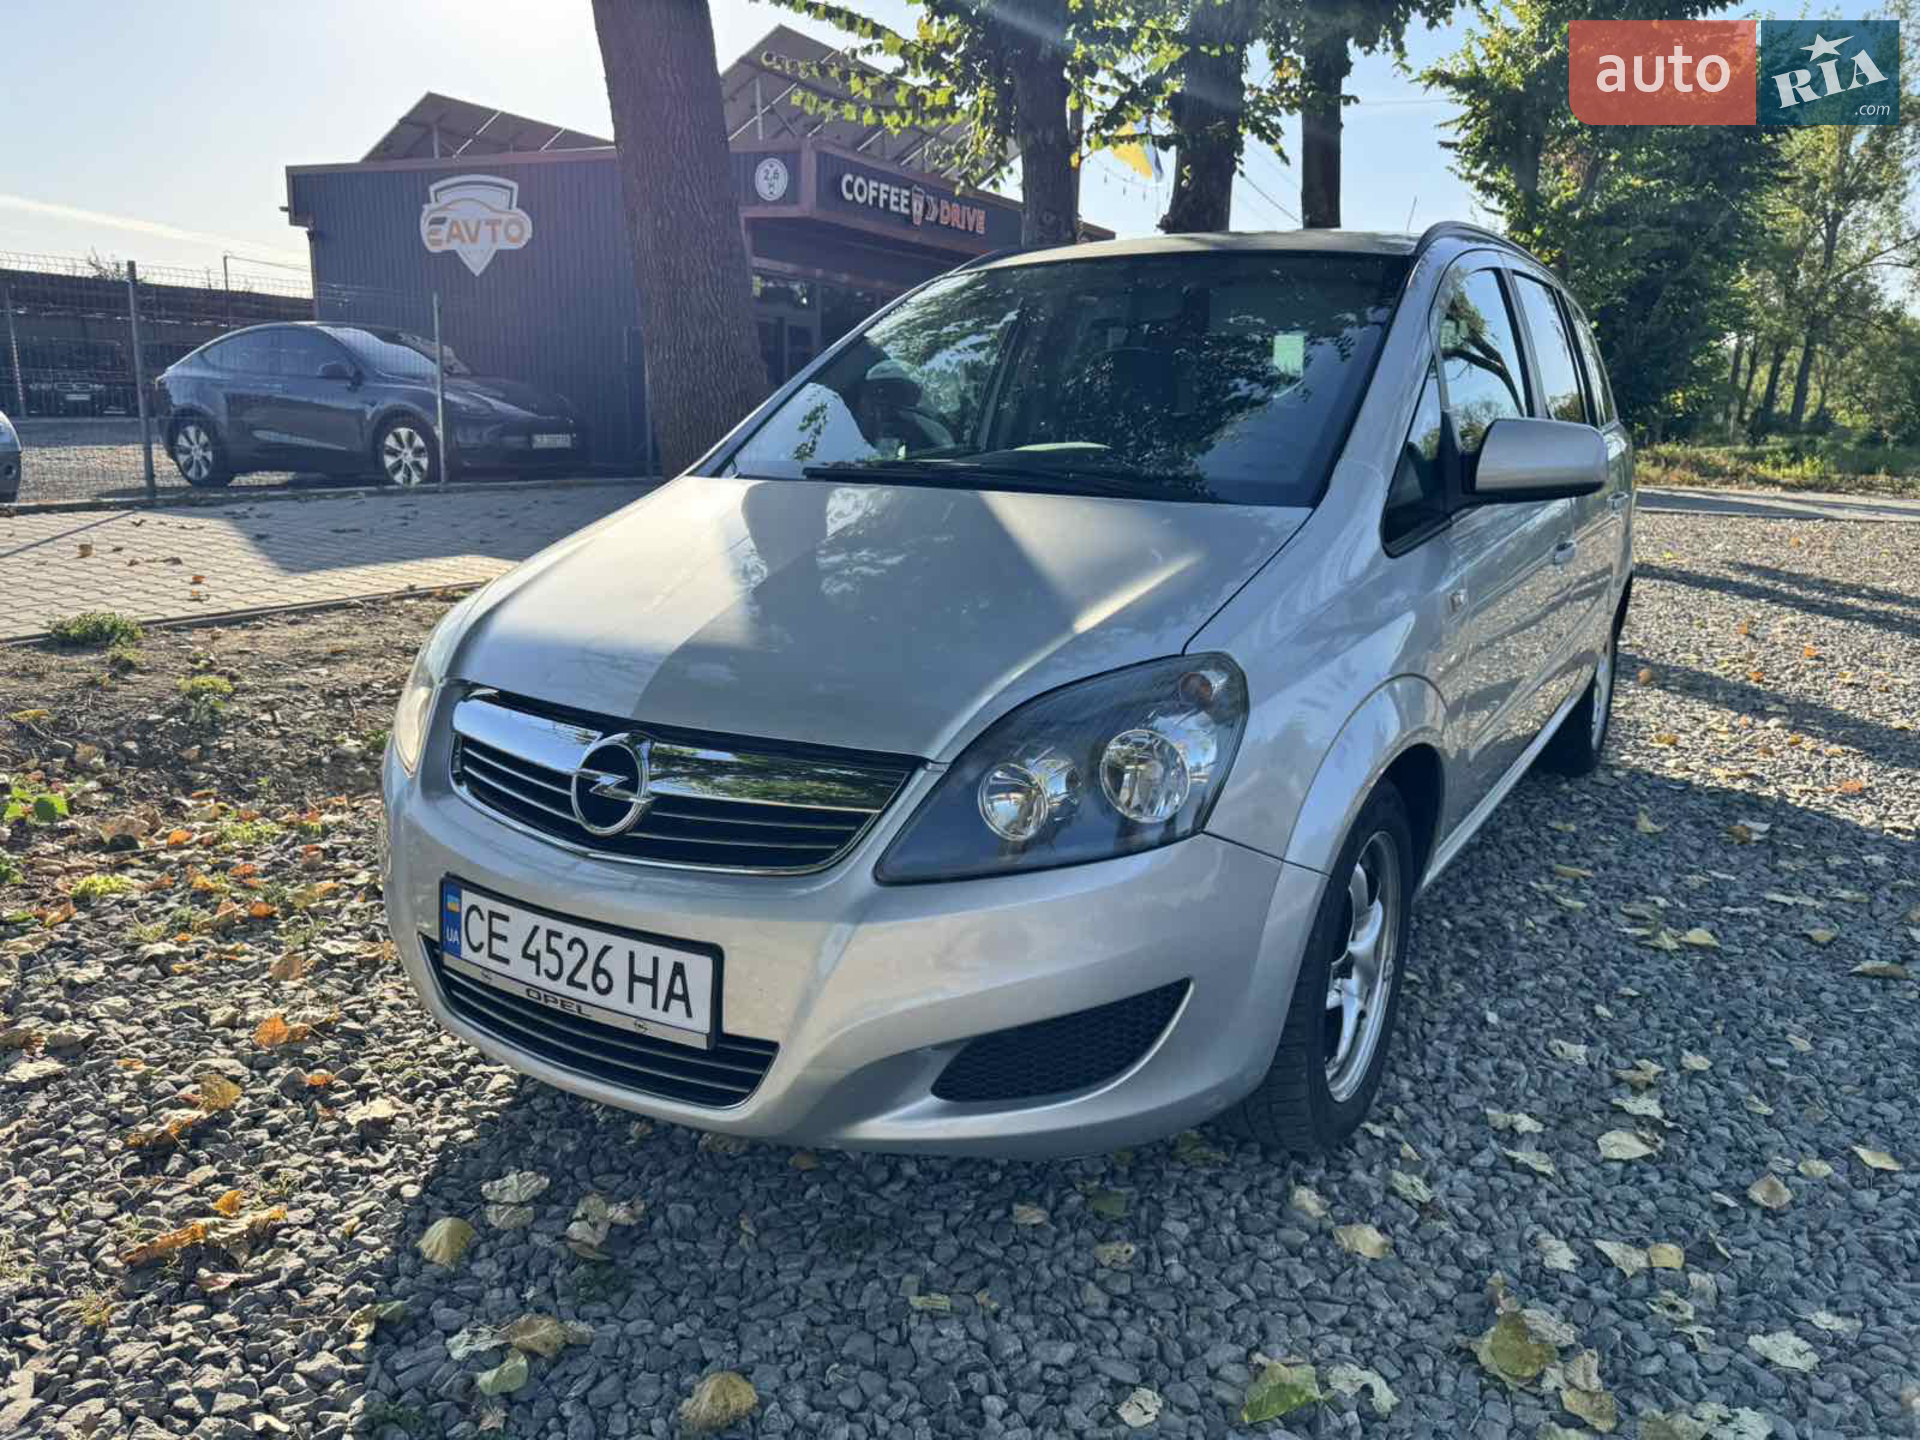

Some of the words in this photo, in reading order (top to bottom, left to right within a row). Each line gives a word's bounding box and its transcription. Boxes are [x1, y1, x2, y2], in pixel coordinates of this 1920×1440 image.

[841, 173, 910, 213] COFFEE
[940, 199, 986, 235] DRIVE
[445, 927, 460, 944] UA
[464, 904, 510, 966] CE
[521, 924, 614, 997] 4526
[628, 950, 694, 1020] HA
[526, 988, 594, 1018] OPEL
